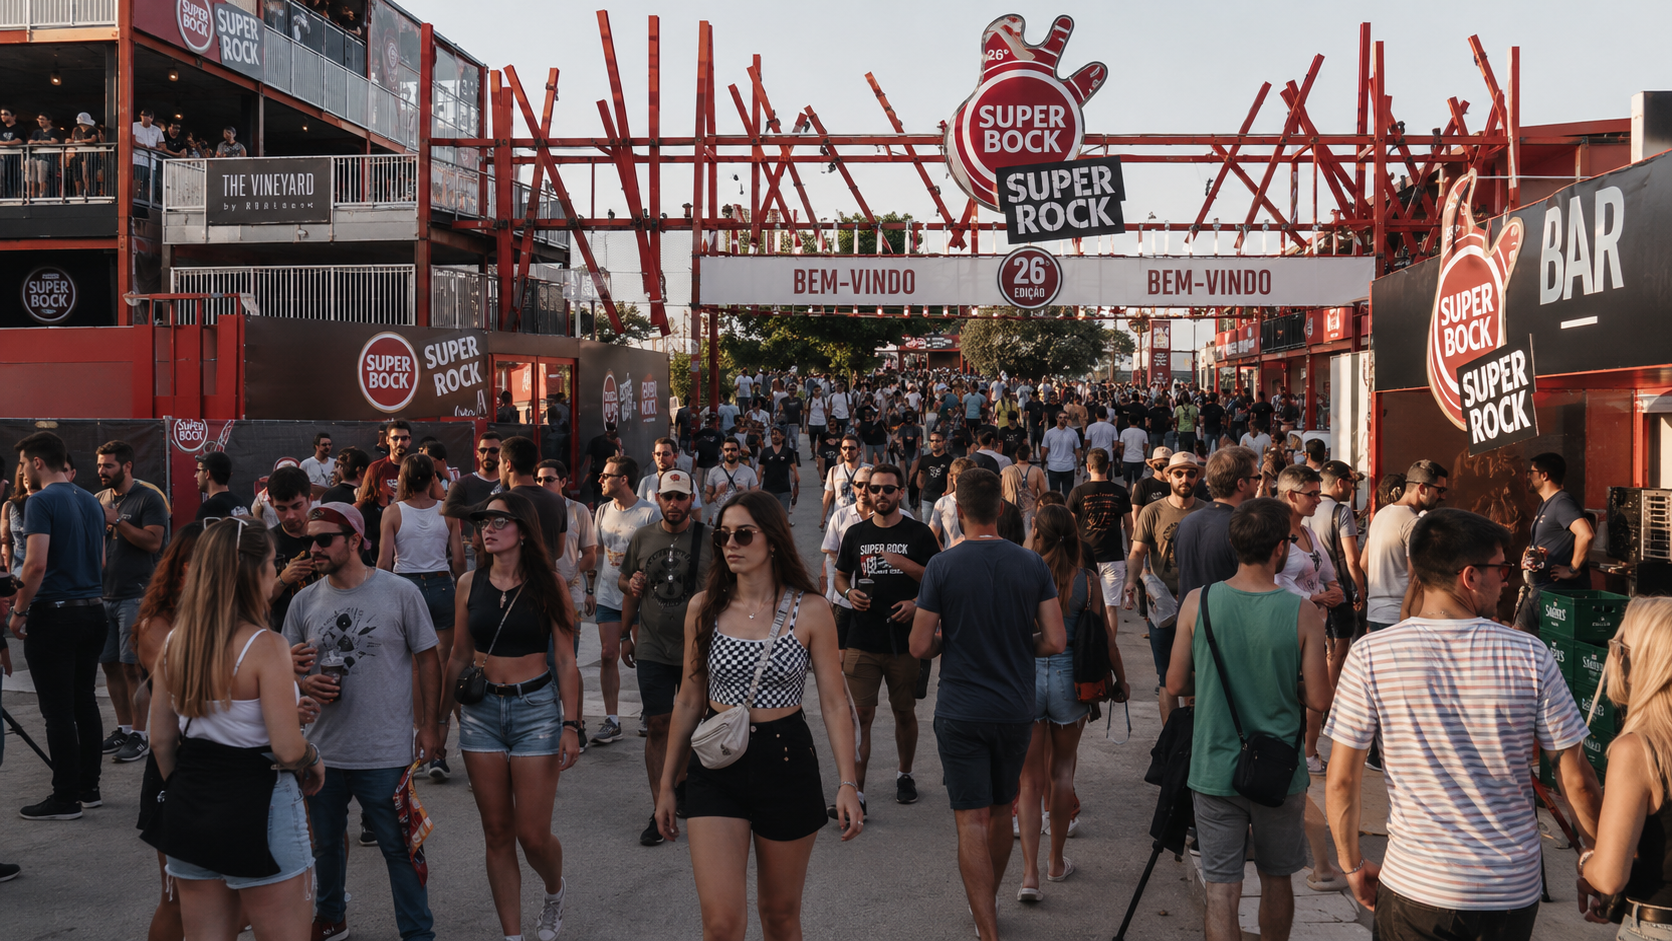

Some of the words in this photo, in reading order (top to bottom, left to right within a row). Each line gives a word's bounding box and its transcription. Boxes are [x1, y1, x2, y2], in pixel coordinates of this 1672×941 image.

[182, 0, 208, 22] SUPER
[217, 8, 259, 40] SUPER
[183, 13, 208, 38] BOCK
[222, 35, 260, 66] ROCK
[979, 105, 1066, 128] SUPER
[984, 130, 1062, 153] BOCK
[222, 174, 246, 197] THE
[251, 173, 314, 196] VINEYARD
[1006, 165, 1115, 203] SUPER
[1015, 196, 1115, 235] ROCK
[1540, 186, 1624, 305] BAR
[29, 281, 69, 294] SUPER
[793, 269, 916, 295] BEM-VINDO
[1014, 285, 1045, 300] EDIÇÃO
[1147, 269, 1271, 295] BEM-VINDO
[31, 294, 68, 308] BOCK
[1441, 282, 1494, 326] SUPER
[1444, 316, 1493, 358] BOCK
[366, 354, 411, 372] SUPER
[424, 335, 480, 369] SUPER
[369, 372, 409, 389] BOCK
[433, 361, 482, 397] ROCK
[1462, 350, 1529, 408] SUPER
[1469, 389, 1531, 445] ROCK
[860, 544, 884, 555] SUPER
